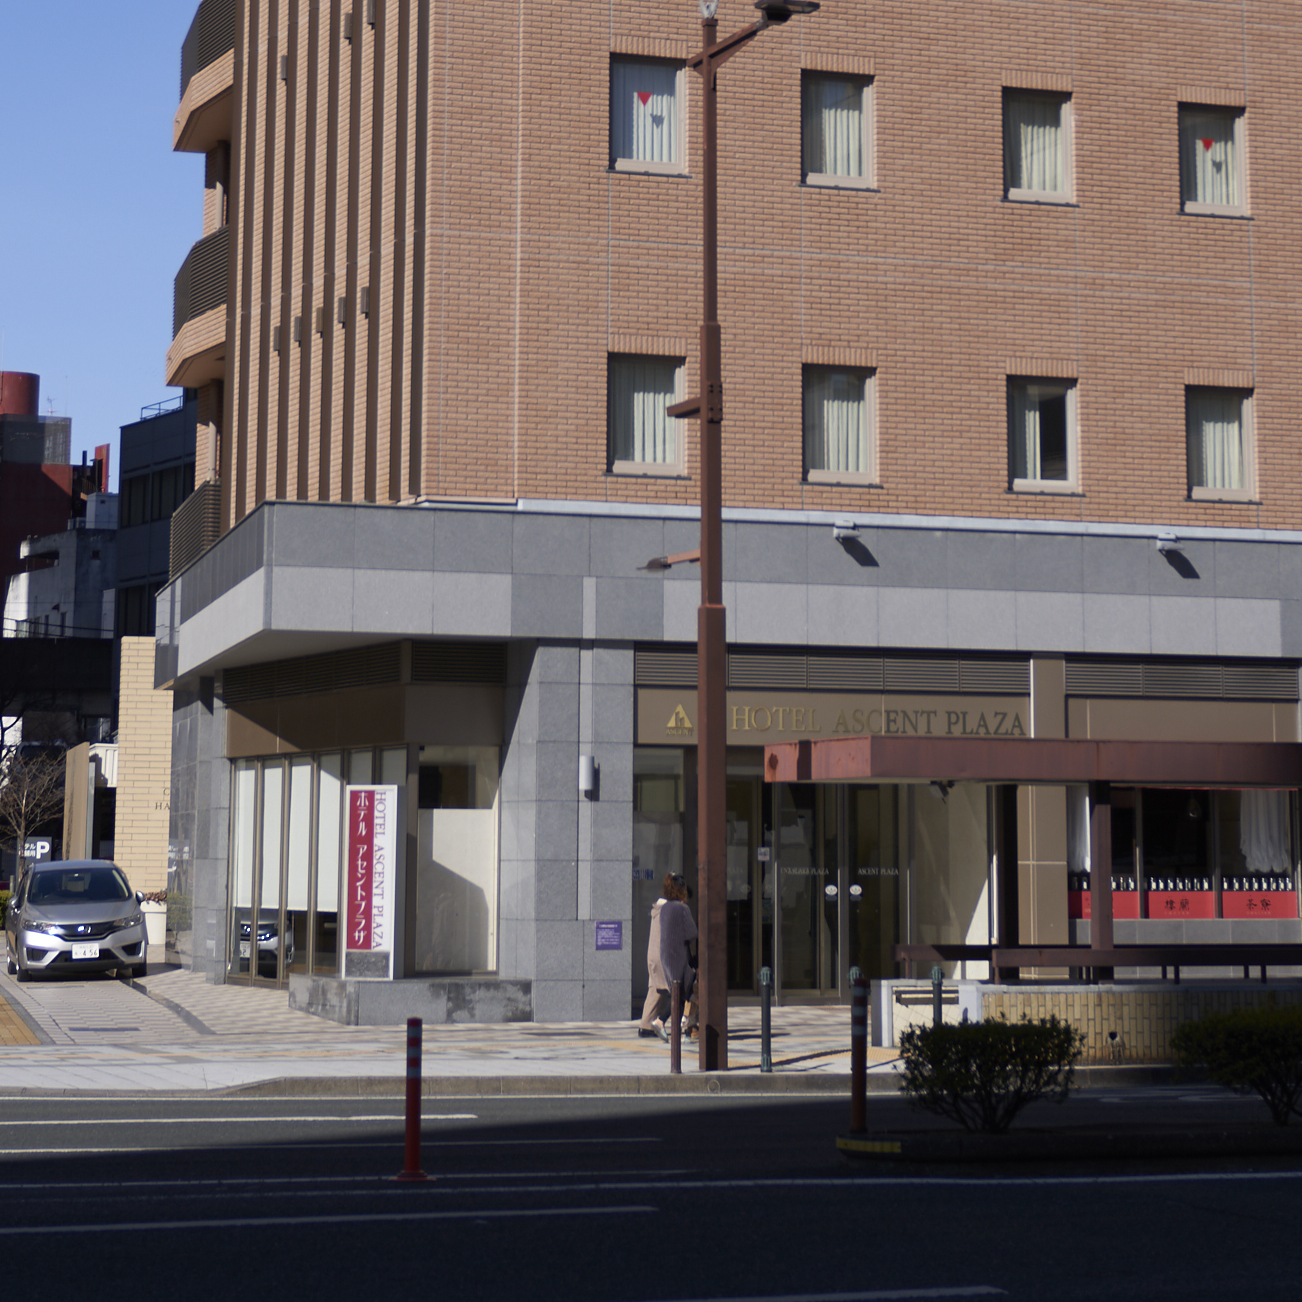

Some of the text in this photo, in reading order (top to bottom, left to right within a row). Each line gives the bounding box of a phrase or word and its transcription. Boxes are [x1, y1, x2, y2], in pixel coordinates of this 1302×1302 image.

[731, 705, 1026, 736] HOTEL ASCENT PLAZA
[357, 791, 369, 837] ホテル
[36, 841, 50, 859] P
[372, 791, 386, 949] HOTEL ASCENT PLAZA
